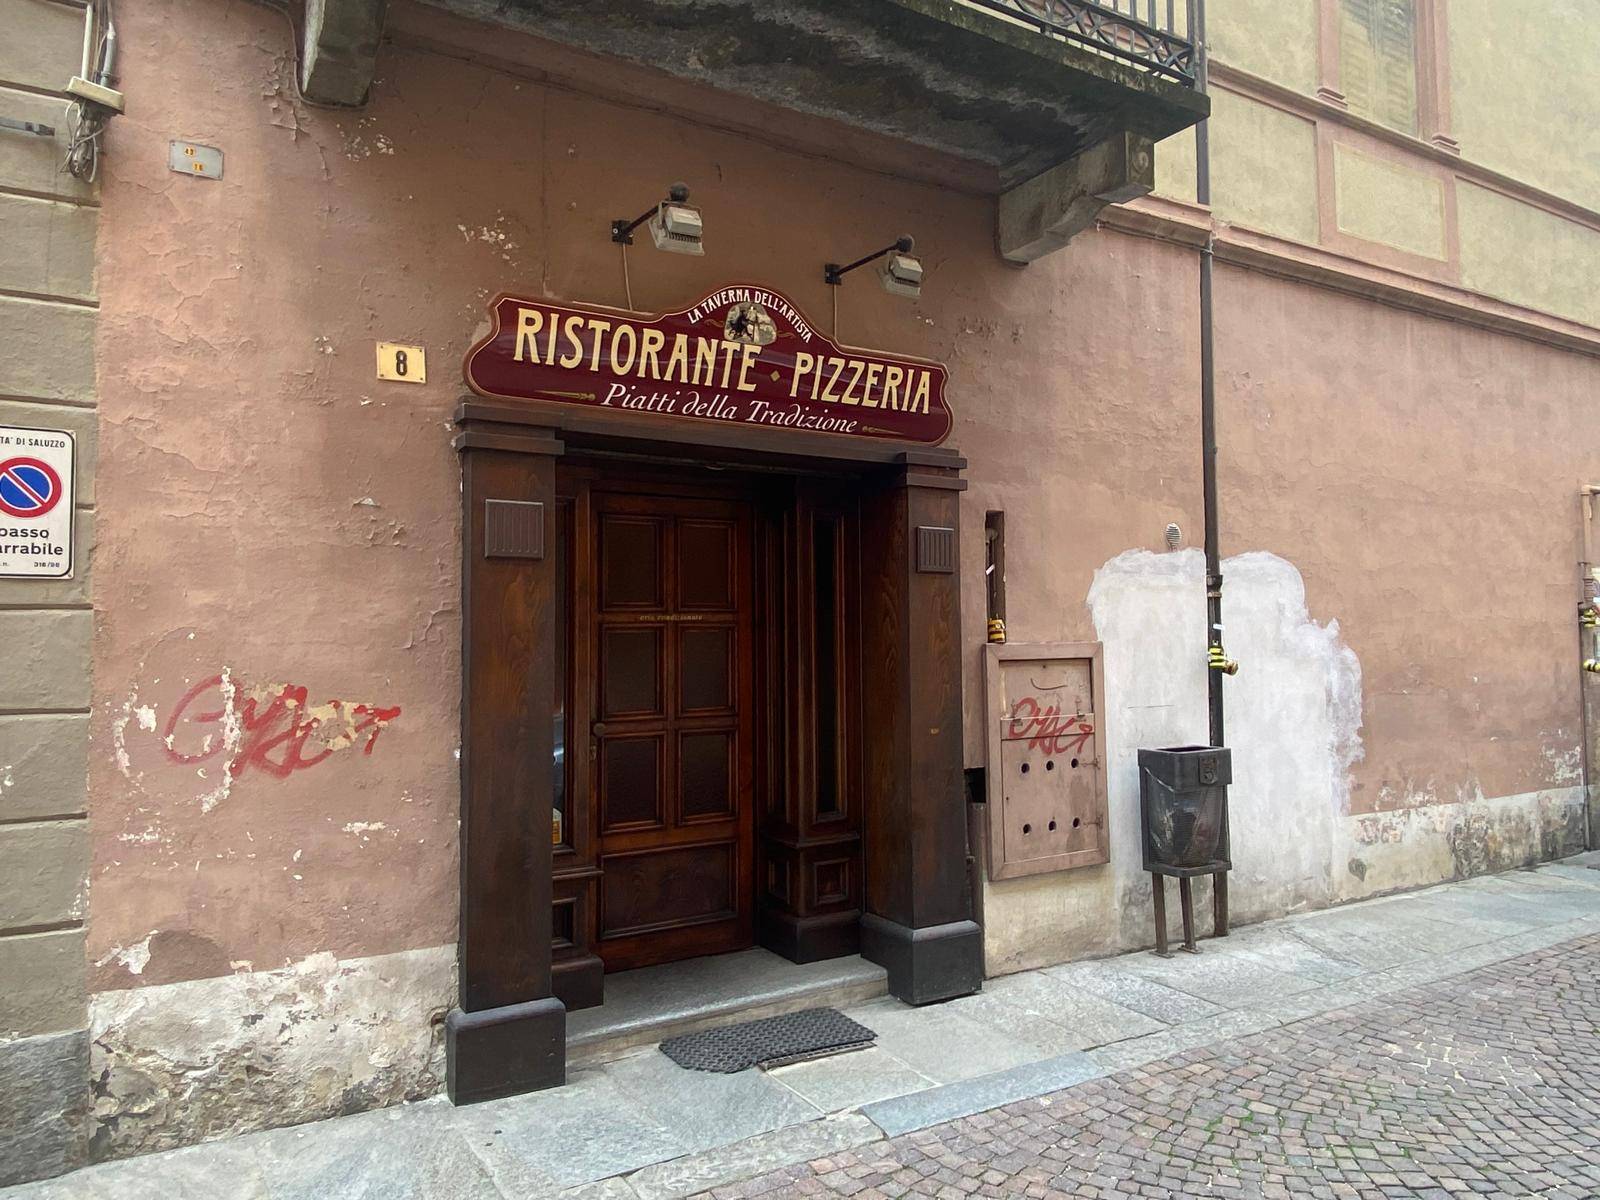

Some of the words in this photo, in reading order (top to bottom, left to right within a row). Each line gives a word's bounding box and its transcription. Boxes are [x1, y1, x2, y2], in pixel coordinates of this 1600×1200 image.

[687, 308, 703, 324] LA
[701, 288, 751, 314] TAVERNA
[754, 290, 812, 344] DELL'ARTISTA
[396, 350, 408, 377] 8
[513, 308, 762, 392] RISTORANTE
[789, 352, 931, 415] PIZZERIA
[600, 382, 677, 413] Piatti
[681, 390, 736, 420] della
[745, 400, 858, 434] Tradizione
[16, 437, 26, 446] DI
[28, 438, 66, 448] SALUZZO
